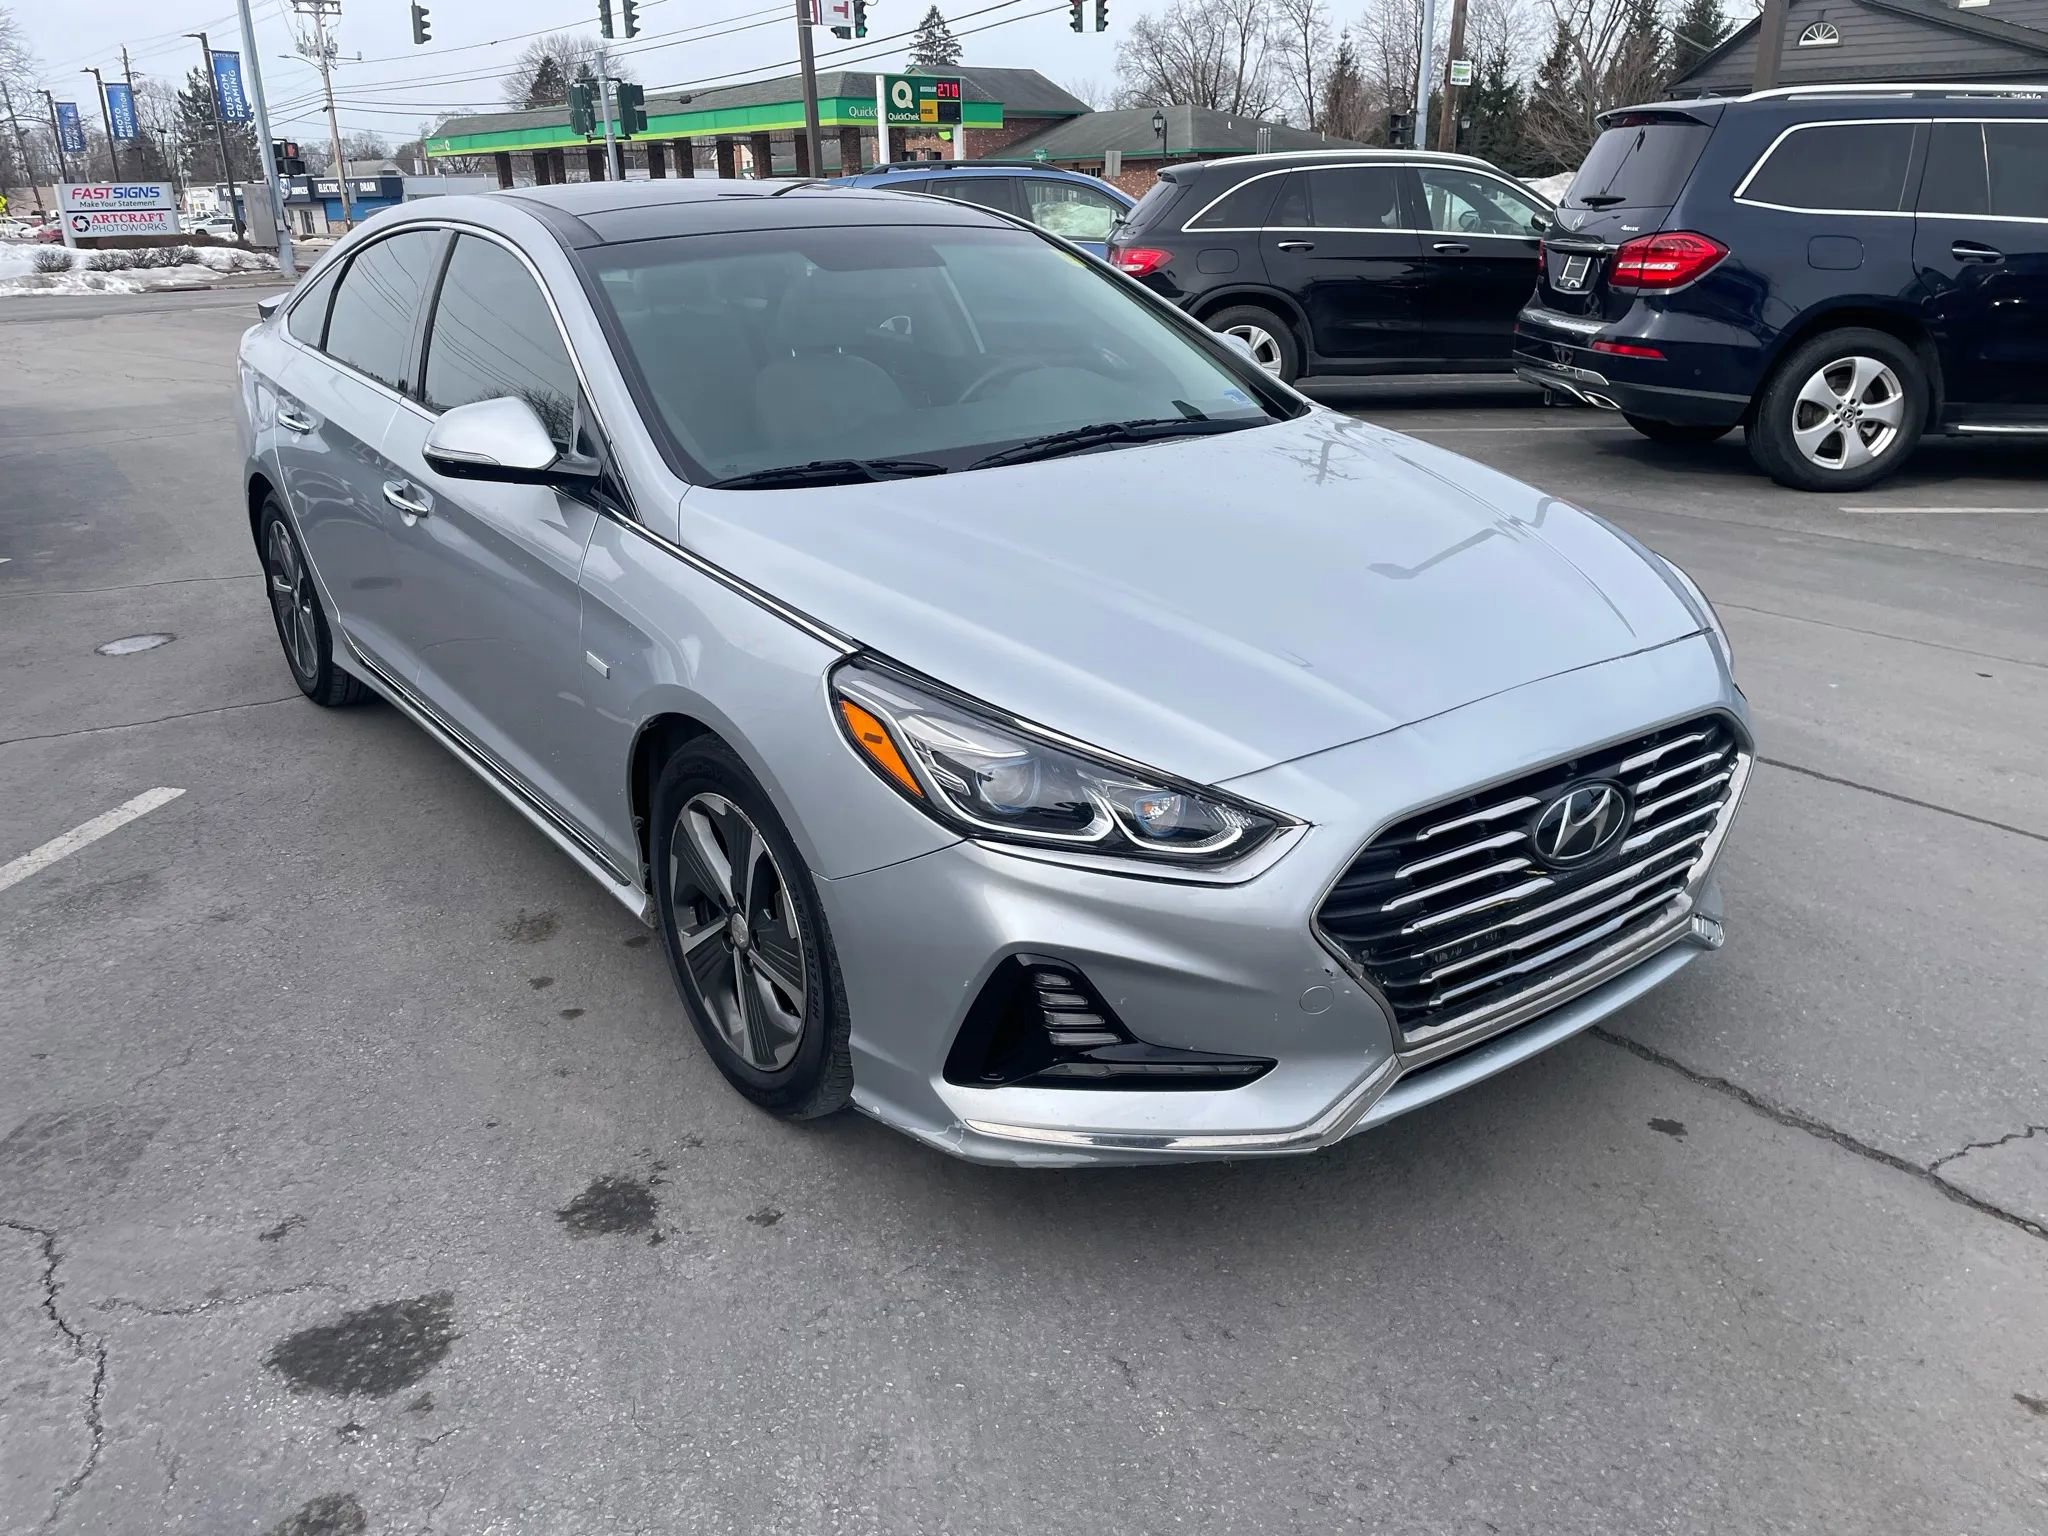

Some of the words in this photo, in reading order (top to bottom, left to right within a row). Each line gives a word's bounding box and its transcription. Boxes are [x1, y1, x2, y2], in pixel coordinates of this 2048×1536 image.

[221, 73, 236, 118] CUSTOM
[229, 69, 245, 118] FRAMING
[891, 80, 914, 109] Q
[114, 107, 126, 138] PHOTO
[120, 92, 134, 138] RESTORATION
[887, 112, 920, 121] QuickChek
[71, 186, 161, 200] FASTSIGNS
[118, 199, 156, 207] Statement
[91, 212, 165, 224] ARTCRAFT
[92, 222, 168, 233] PHOTOWORKS
